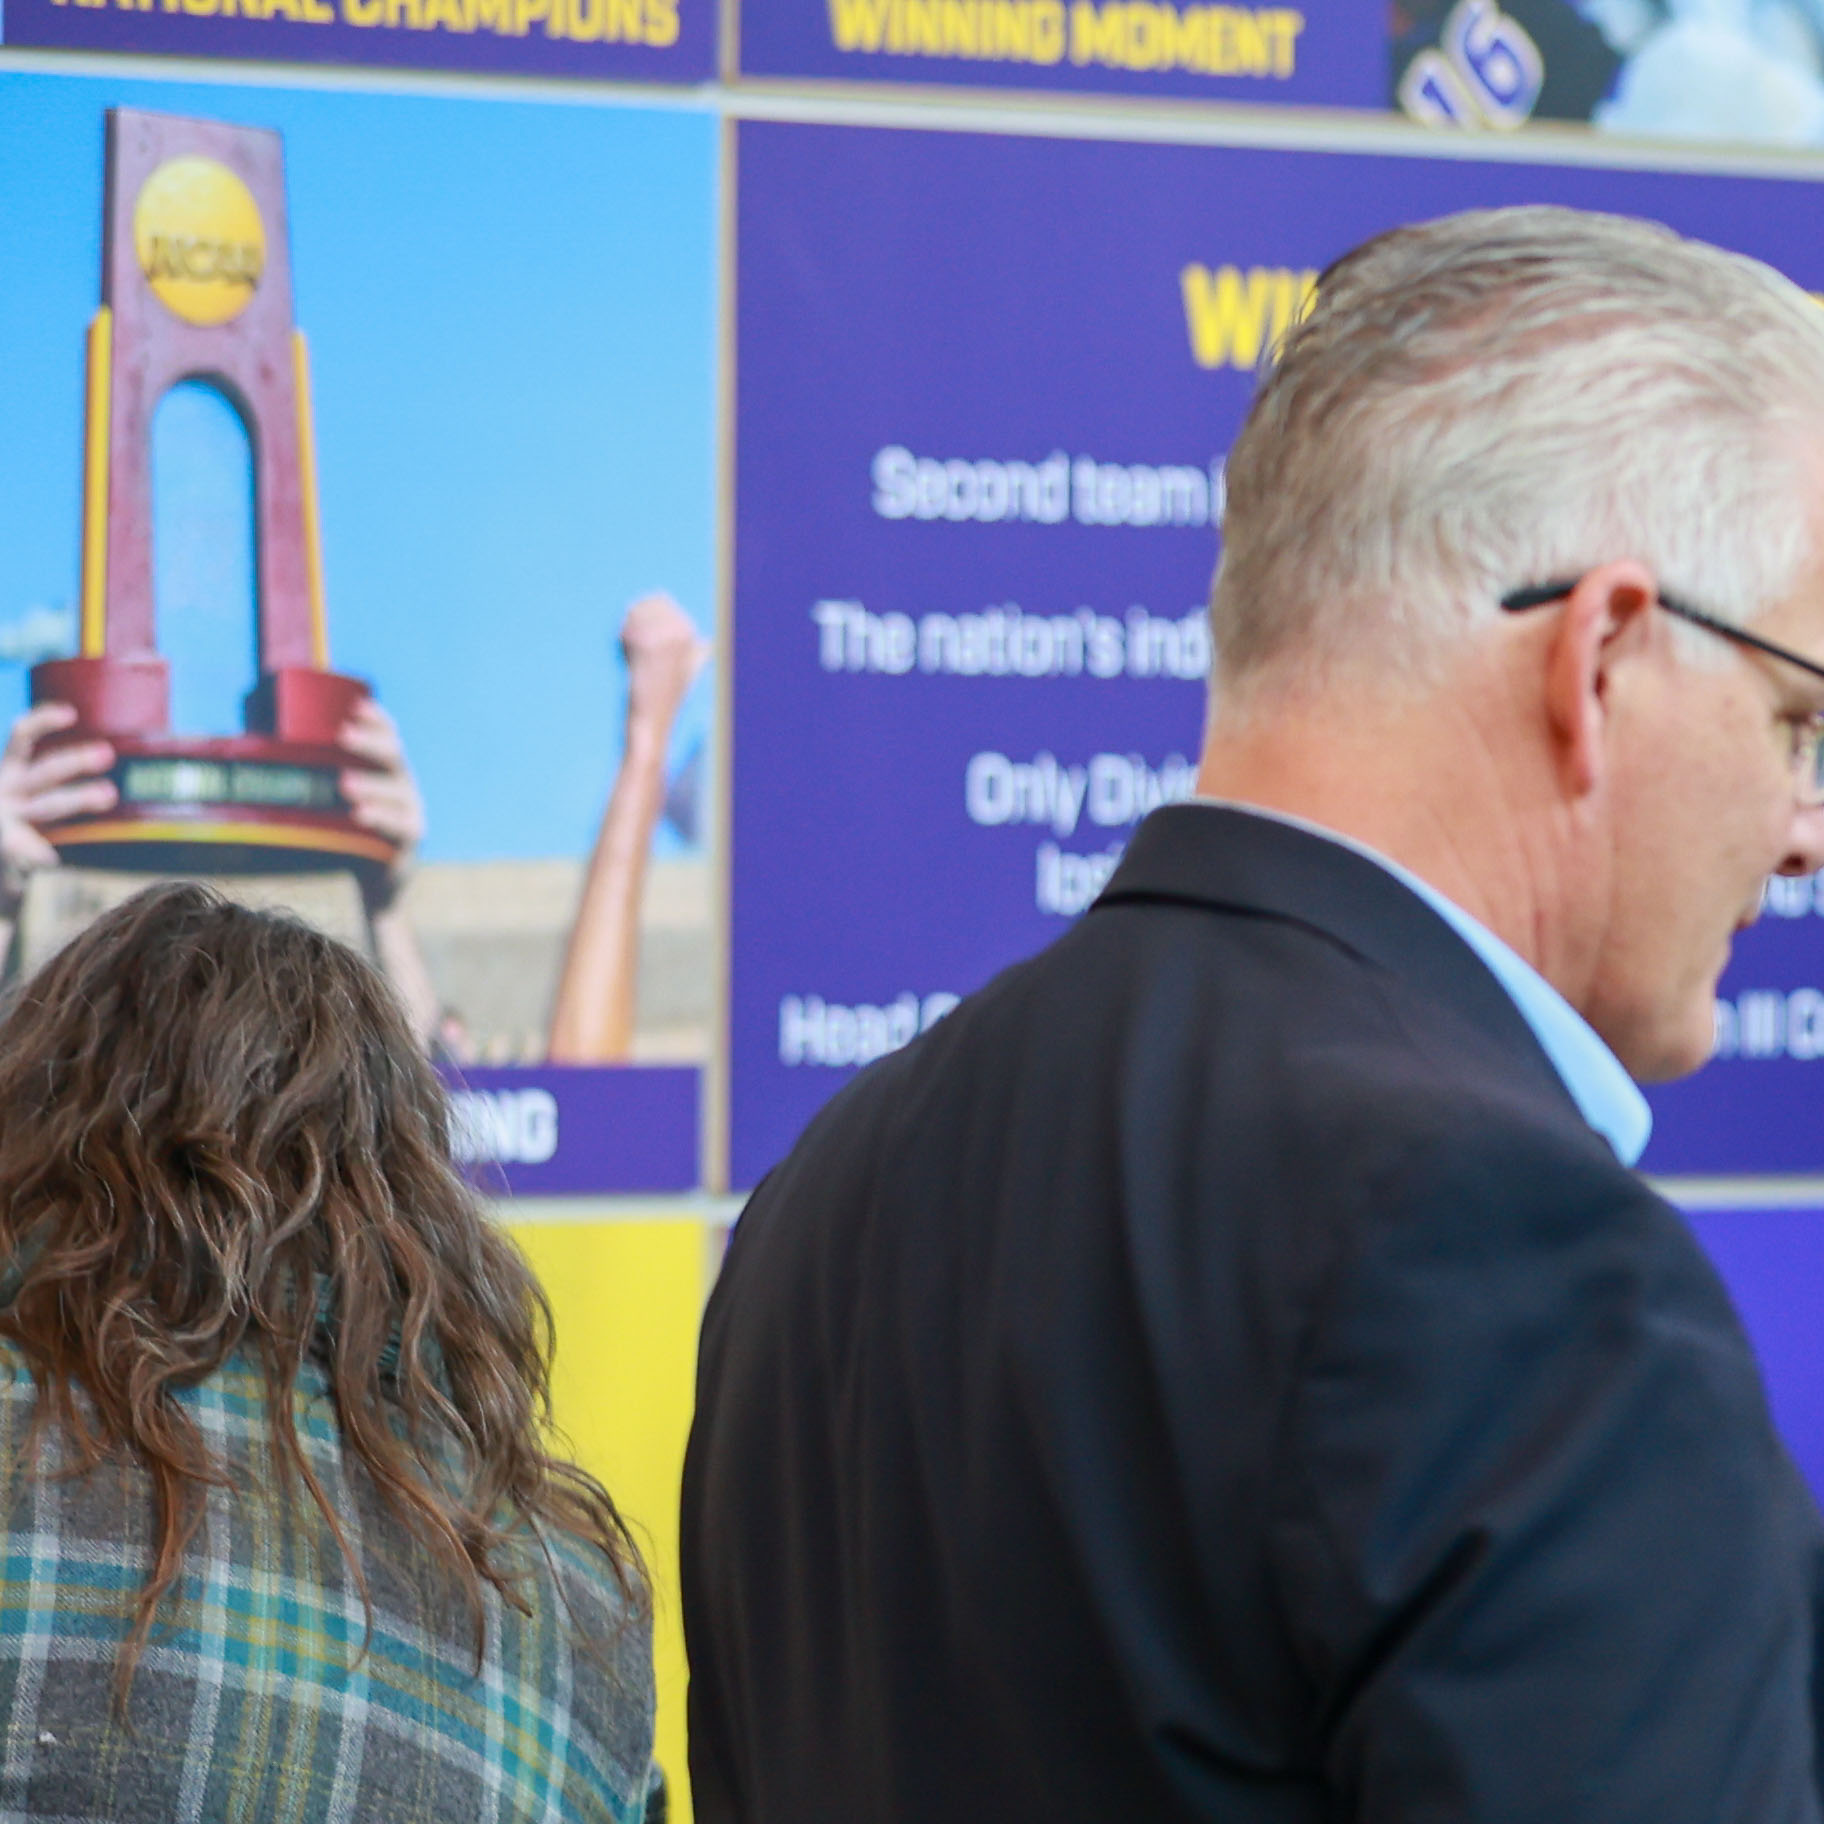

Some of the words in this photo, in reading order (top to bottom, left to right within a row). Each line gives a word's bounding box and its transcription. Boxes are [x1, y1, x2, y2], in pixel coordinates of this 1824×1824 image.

[827, 0, 1066, 64] WINNING
[1072, 5, 1303, 78] MOMENT
[871, 444, 1070, 524] Second
[1072, 453, 1208, 527] team
[811, 598, 917, 673] The
[919, 602, 1124, 678] nation's
[966, 751, 1087, 838] Only
[778, 989, 920, 1068] Head
